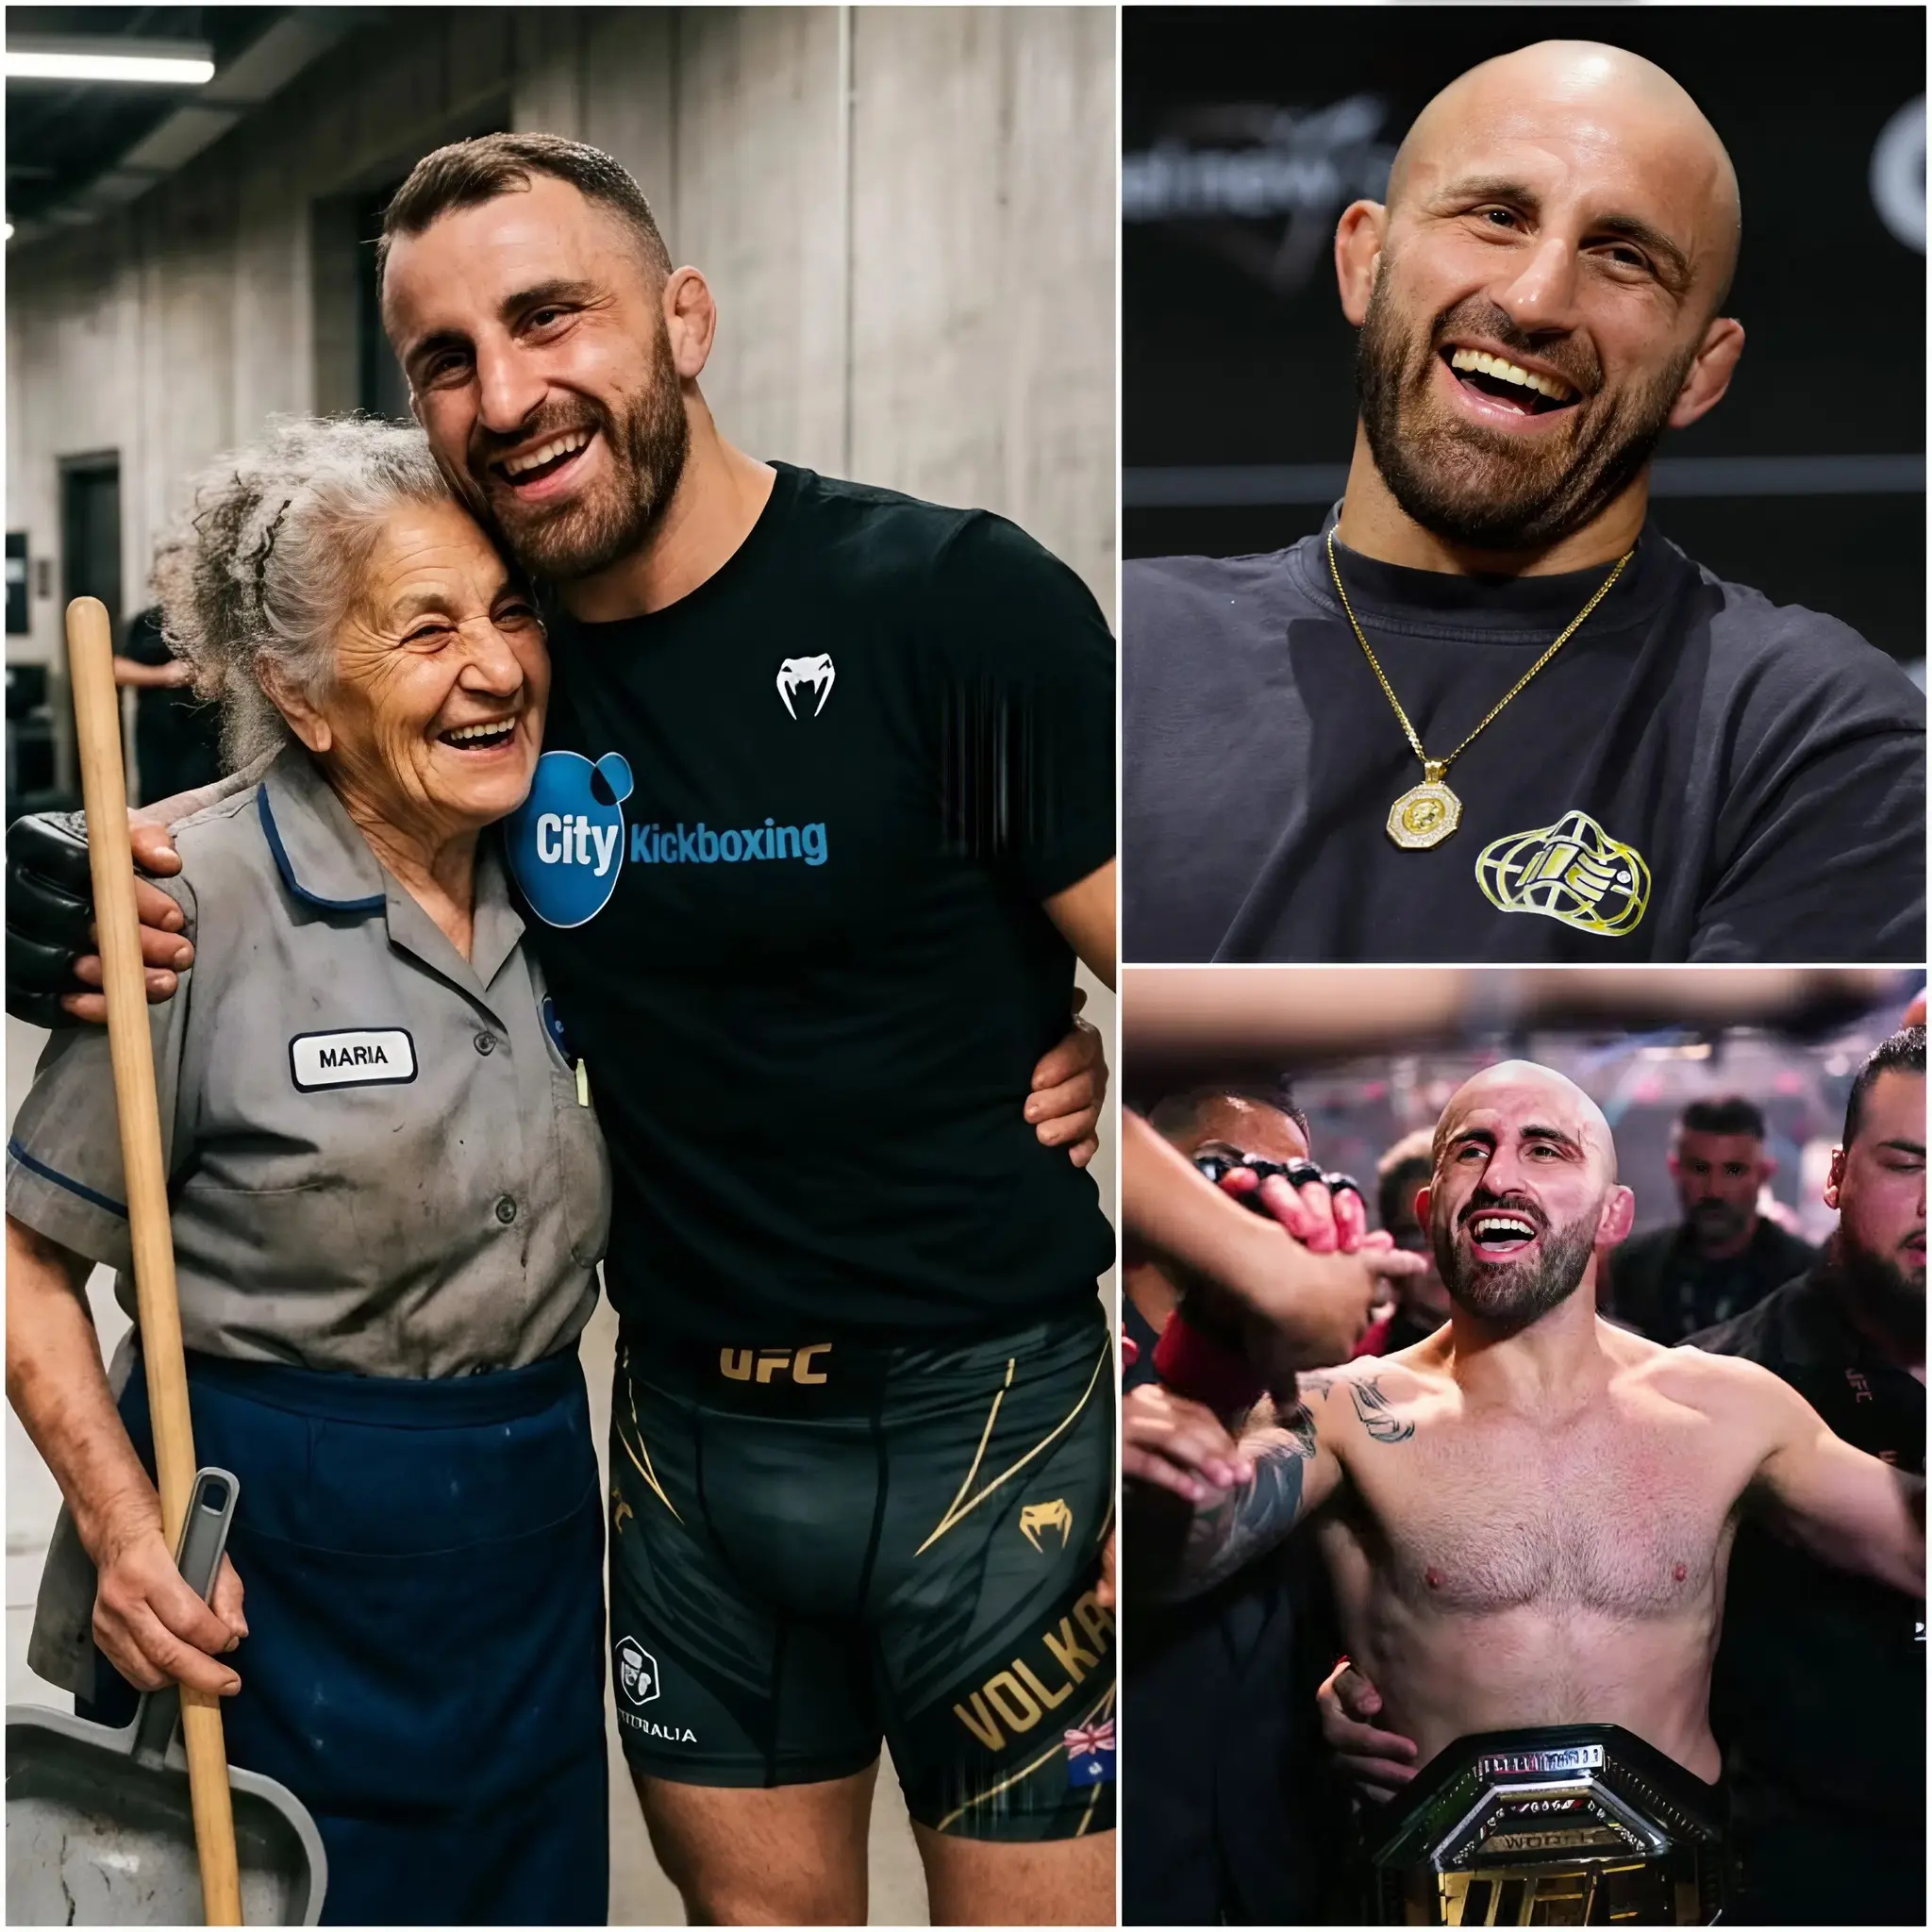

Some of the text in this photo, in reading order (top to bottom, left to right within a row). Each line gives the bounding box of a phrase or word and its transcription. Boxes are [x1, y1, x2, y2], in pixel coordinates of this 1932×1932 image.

[537, 812, 828, 877] City Kickboxing
[319, 1045, 389, 1069] MARIA
[720, 1342, 832, 1385] UFC
